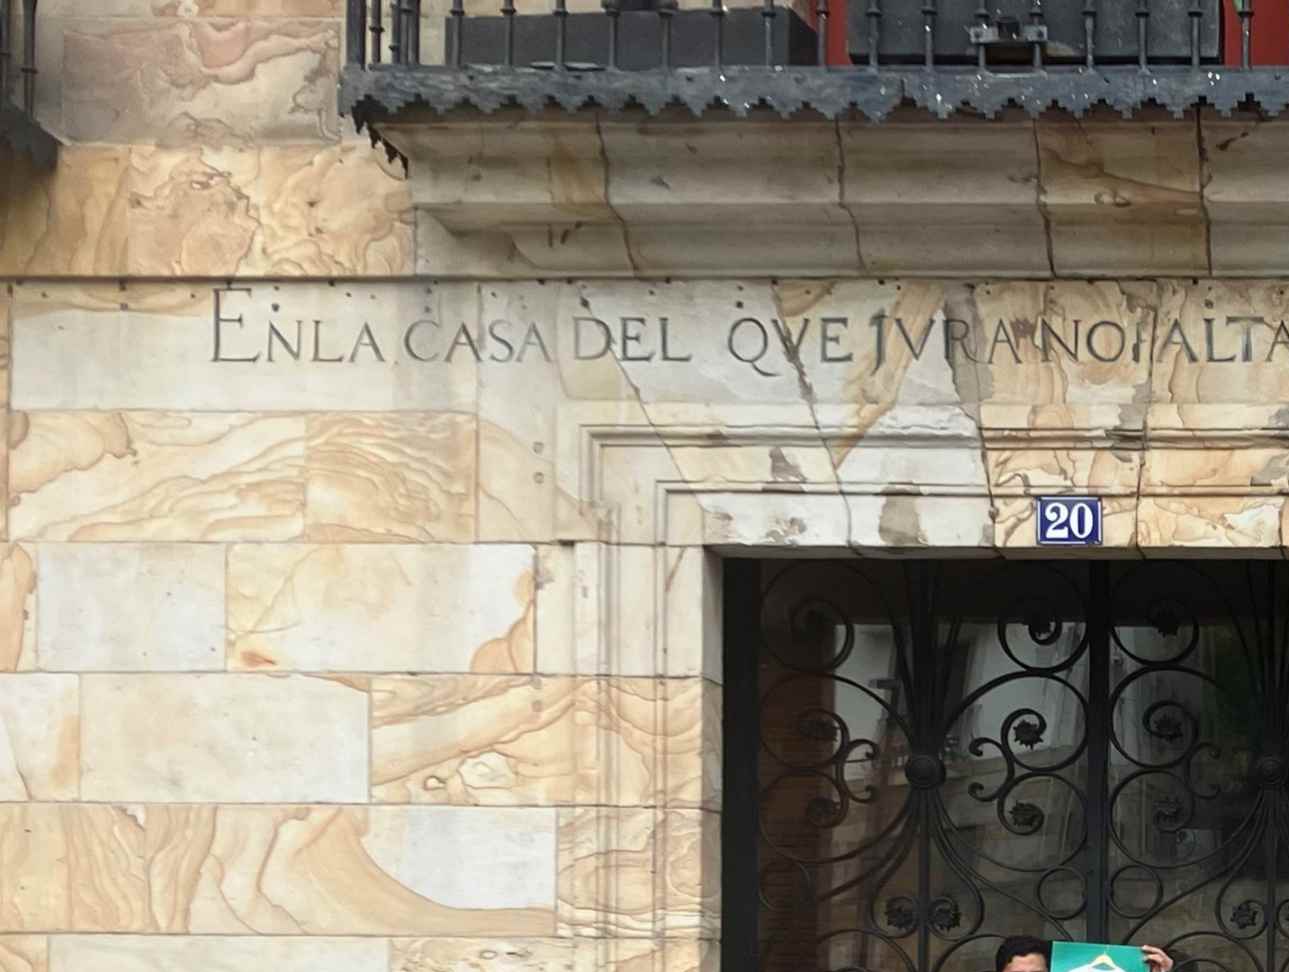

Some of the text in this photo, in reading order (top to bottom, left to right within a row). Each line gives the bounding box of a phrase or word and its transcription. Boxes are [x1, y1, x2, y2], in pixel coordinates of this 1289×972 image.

[403, 318, 553, 364] CASA
[571, 316, 692, 364] DEL
[727, 316, 854, 378] QVE
[868, 309, 1022, 377] JVRA
[1044, 501, 1094, 539] 20
